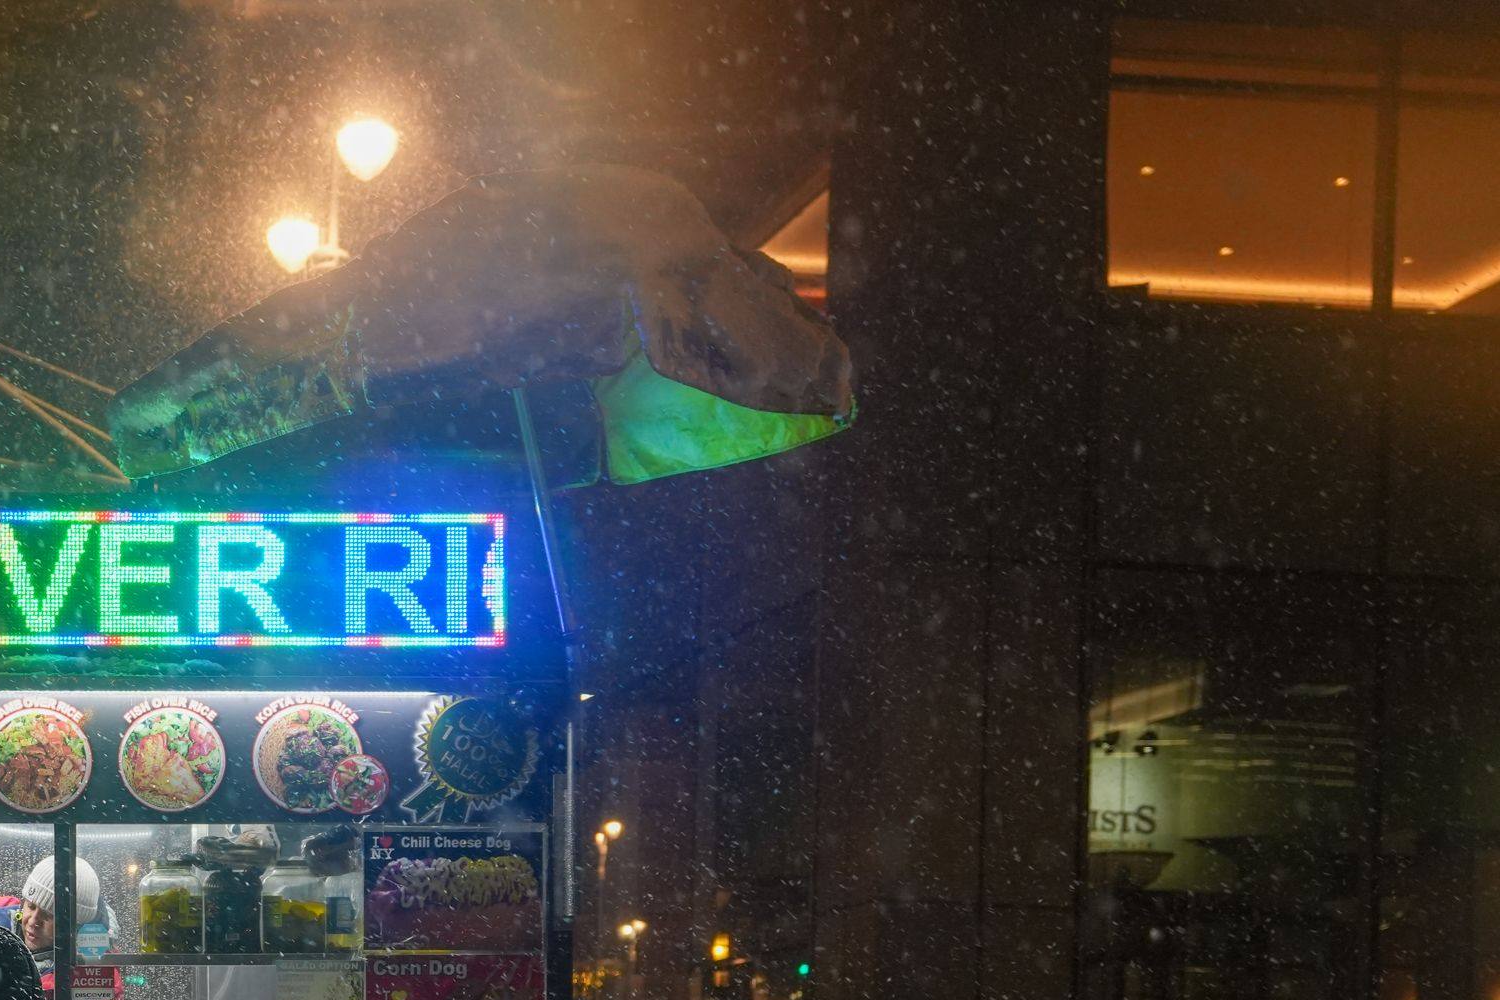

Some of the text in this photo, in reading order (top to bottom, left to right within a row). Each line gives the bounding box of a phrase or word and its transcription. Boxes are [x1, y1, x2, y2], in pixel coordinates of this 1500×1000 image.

[56, 700, 84, 723] RICE
[123, 696, 218, 723] FISH OVER RICE
[255, 694, 360, 725] KOFTA OVER RICE
[440, 751, 487, 789] HALAL
[401, 836, 512, 850] Chili Cheese Dog
[370, 848, 395, 860] NY
[85, 967, 101, 976] WE
[373, 960, 468, 979] Corn Dog
[73, 978, 114, 987] ACCEPT
